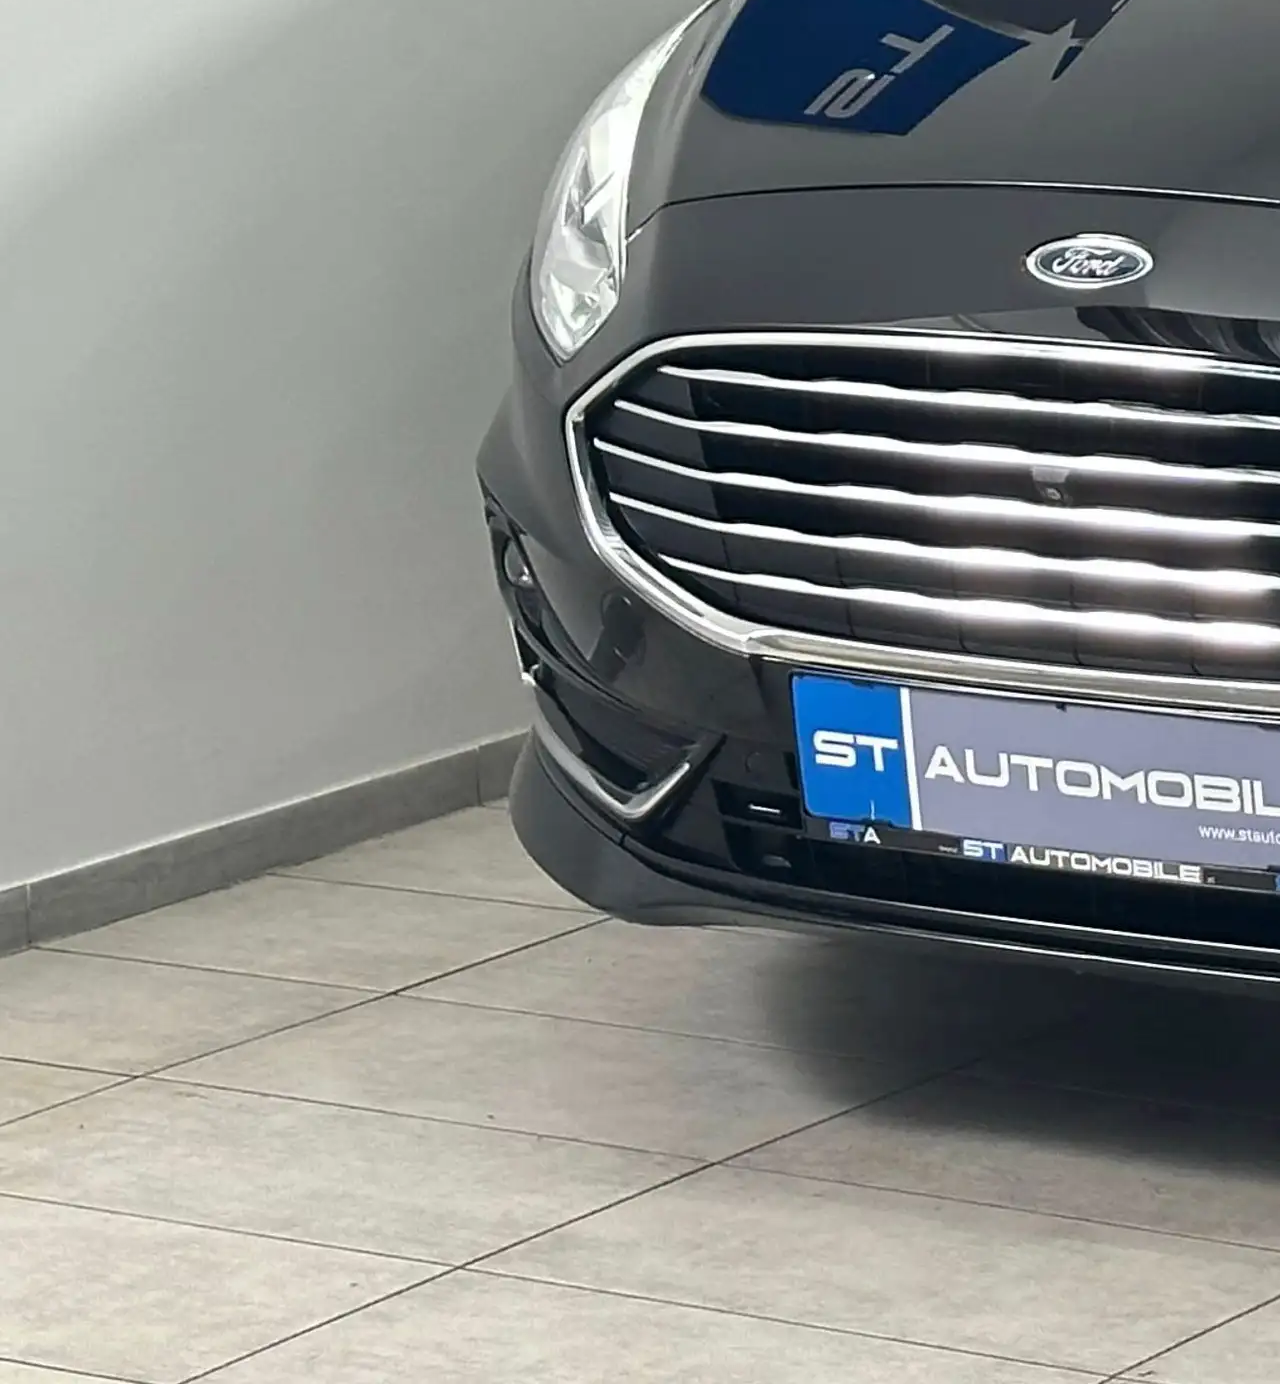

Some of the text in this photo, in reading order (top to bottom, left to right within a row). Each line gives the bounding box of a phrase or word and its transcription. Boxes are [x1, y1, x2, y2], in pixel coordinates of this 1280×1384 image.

[1051, 247, 1125, 276] Ford
[813, 730, 898, 772] ST
[963, 839, 1202, 883] ST AUTOMOBILE
